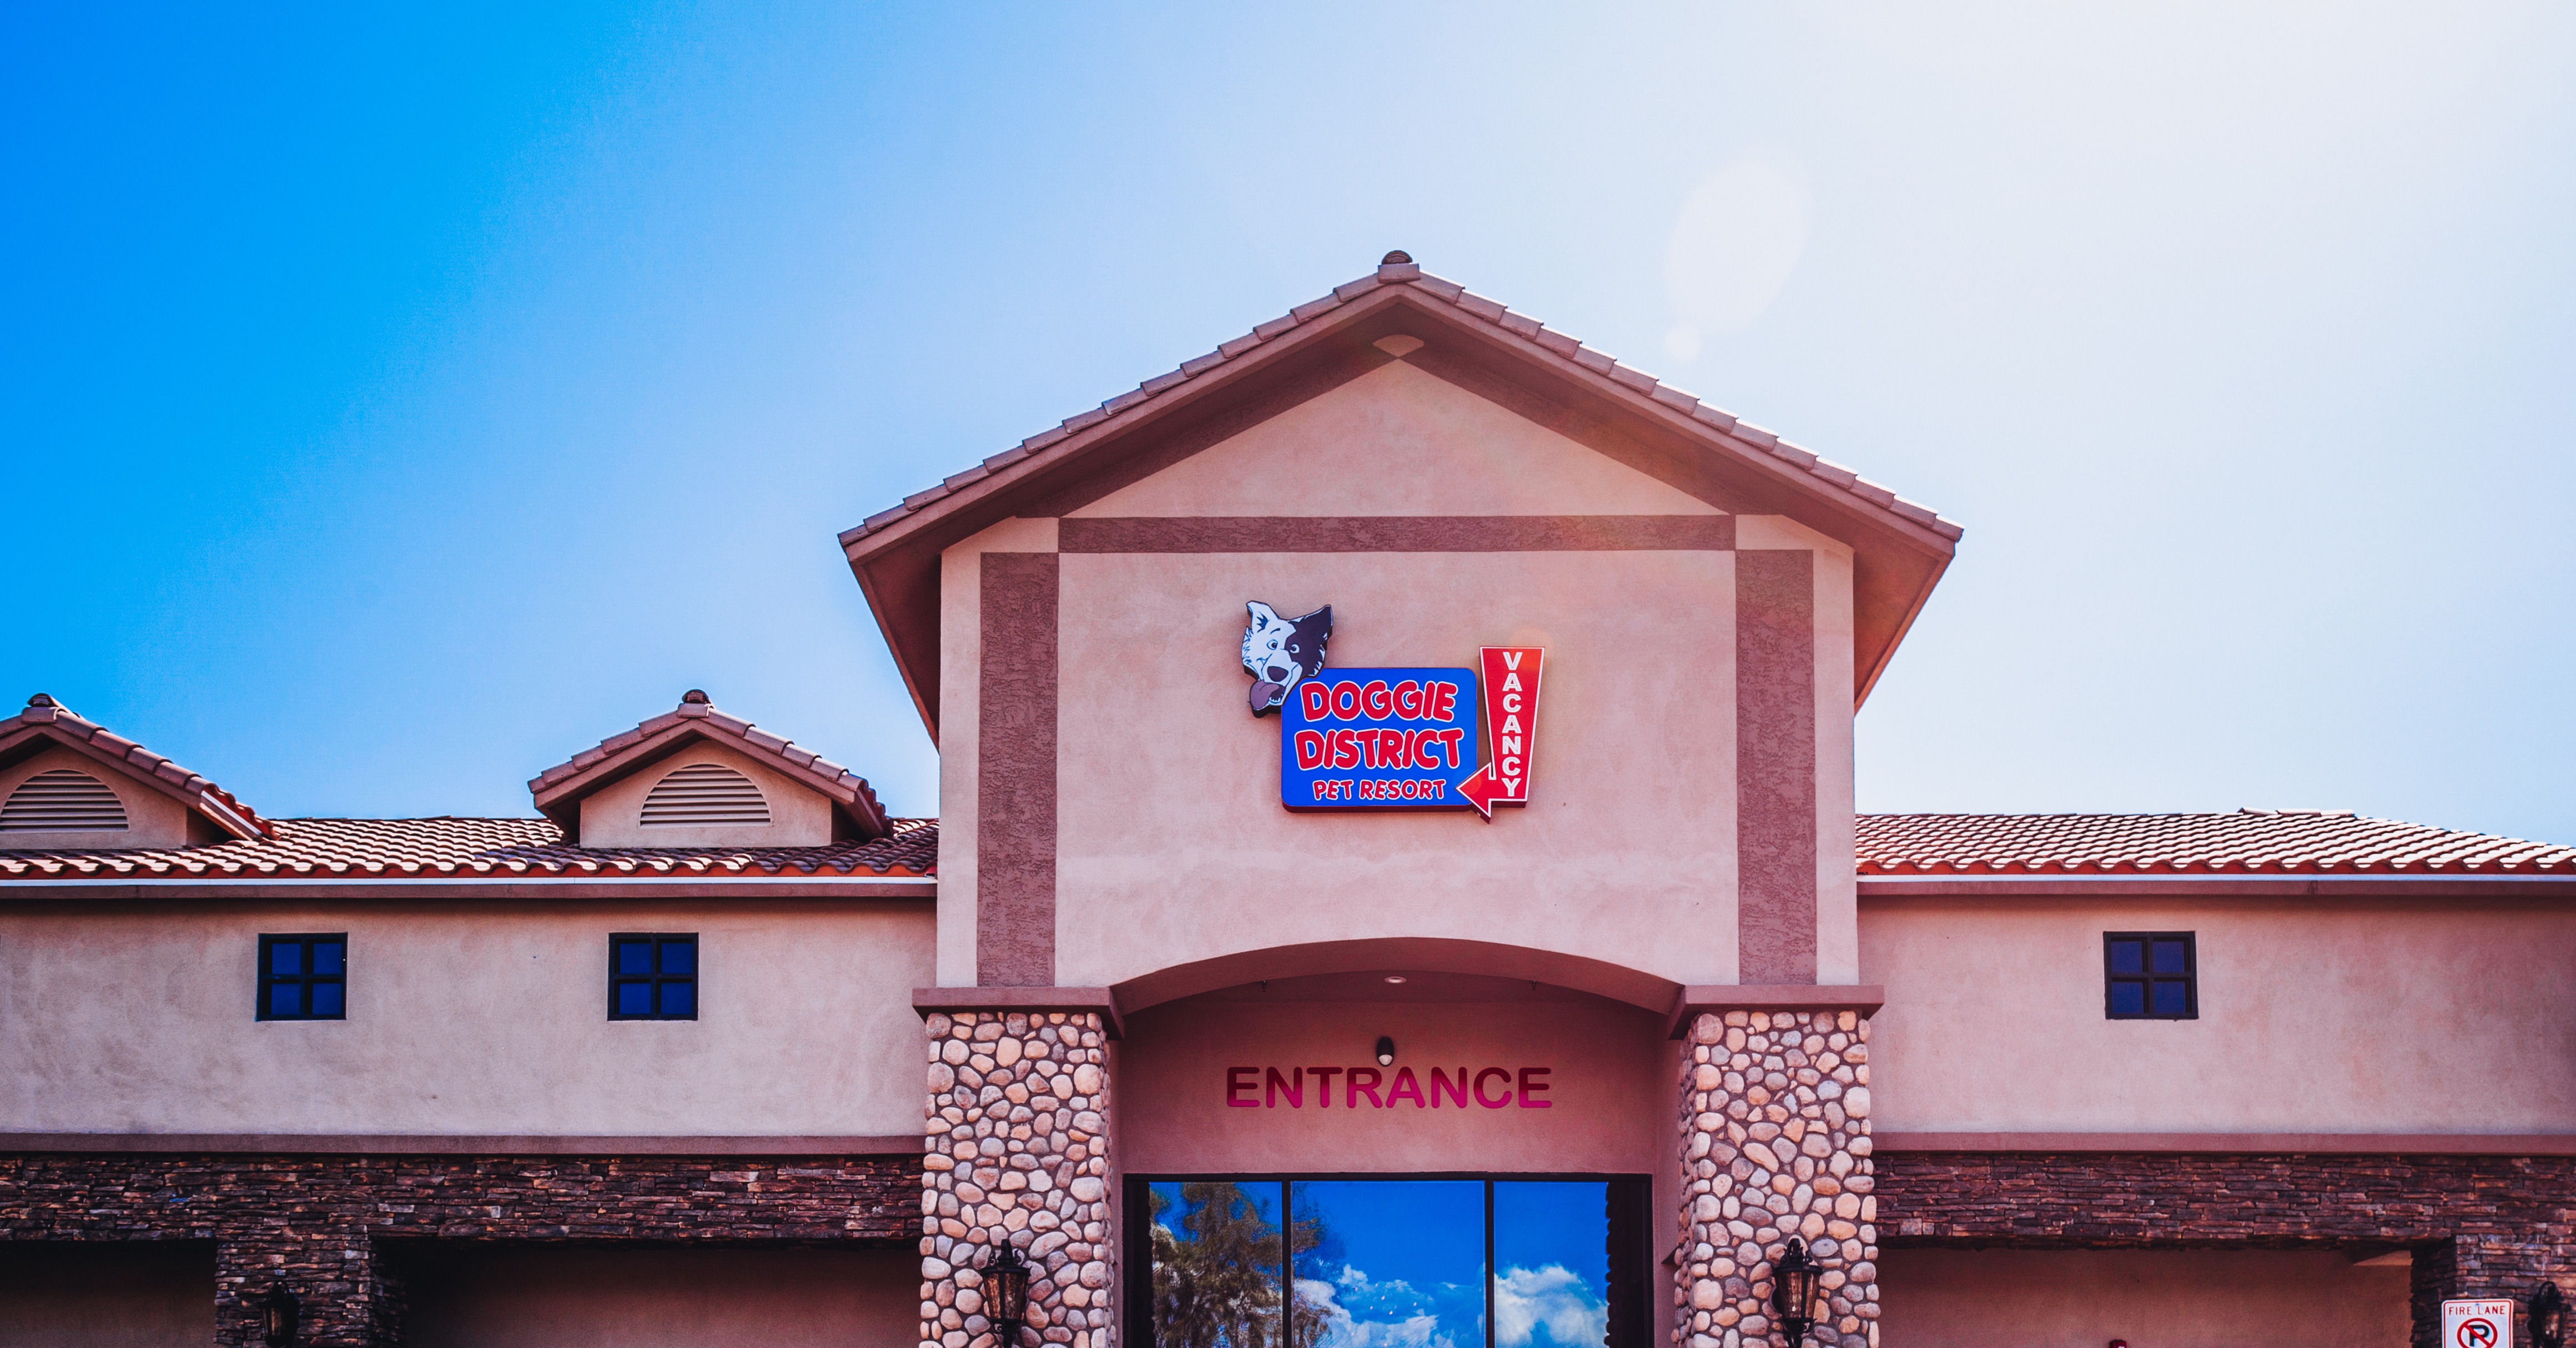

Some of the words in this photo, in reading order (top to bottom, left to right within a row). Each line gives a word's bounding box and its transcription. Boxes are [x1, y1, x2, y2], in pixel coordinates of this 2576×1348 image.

[1300, 680, 1458, 722] DOGGIE
[1501, 651, 1523, 797] VACANCY
[1294, 728, 1464, 771] DISTRICT
[1312, 779, 1354, 801] PET
[1359, 778, 1446, 799] RESORT
[1227, 1067, 1552, 1109] ENTRANCE
[2449, 1306, 2472, 1316] FIRE
[2477, 1305, 2505, 1315] LANE
